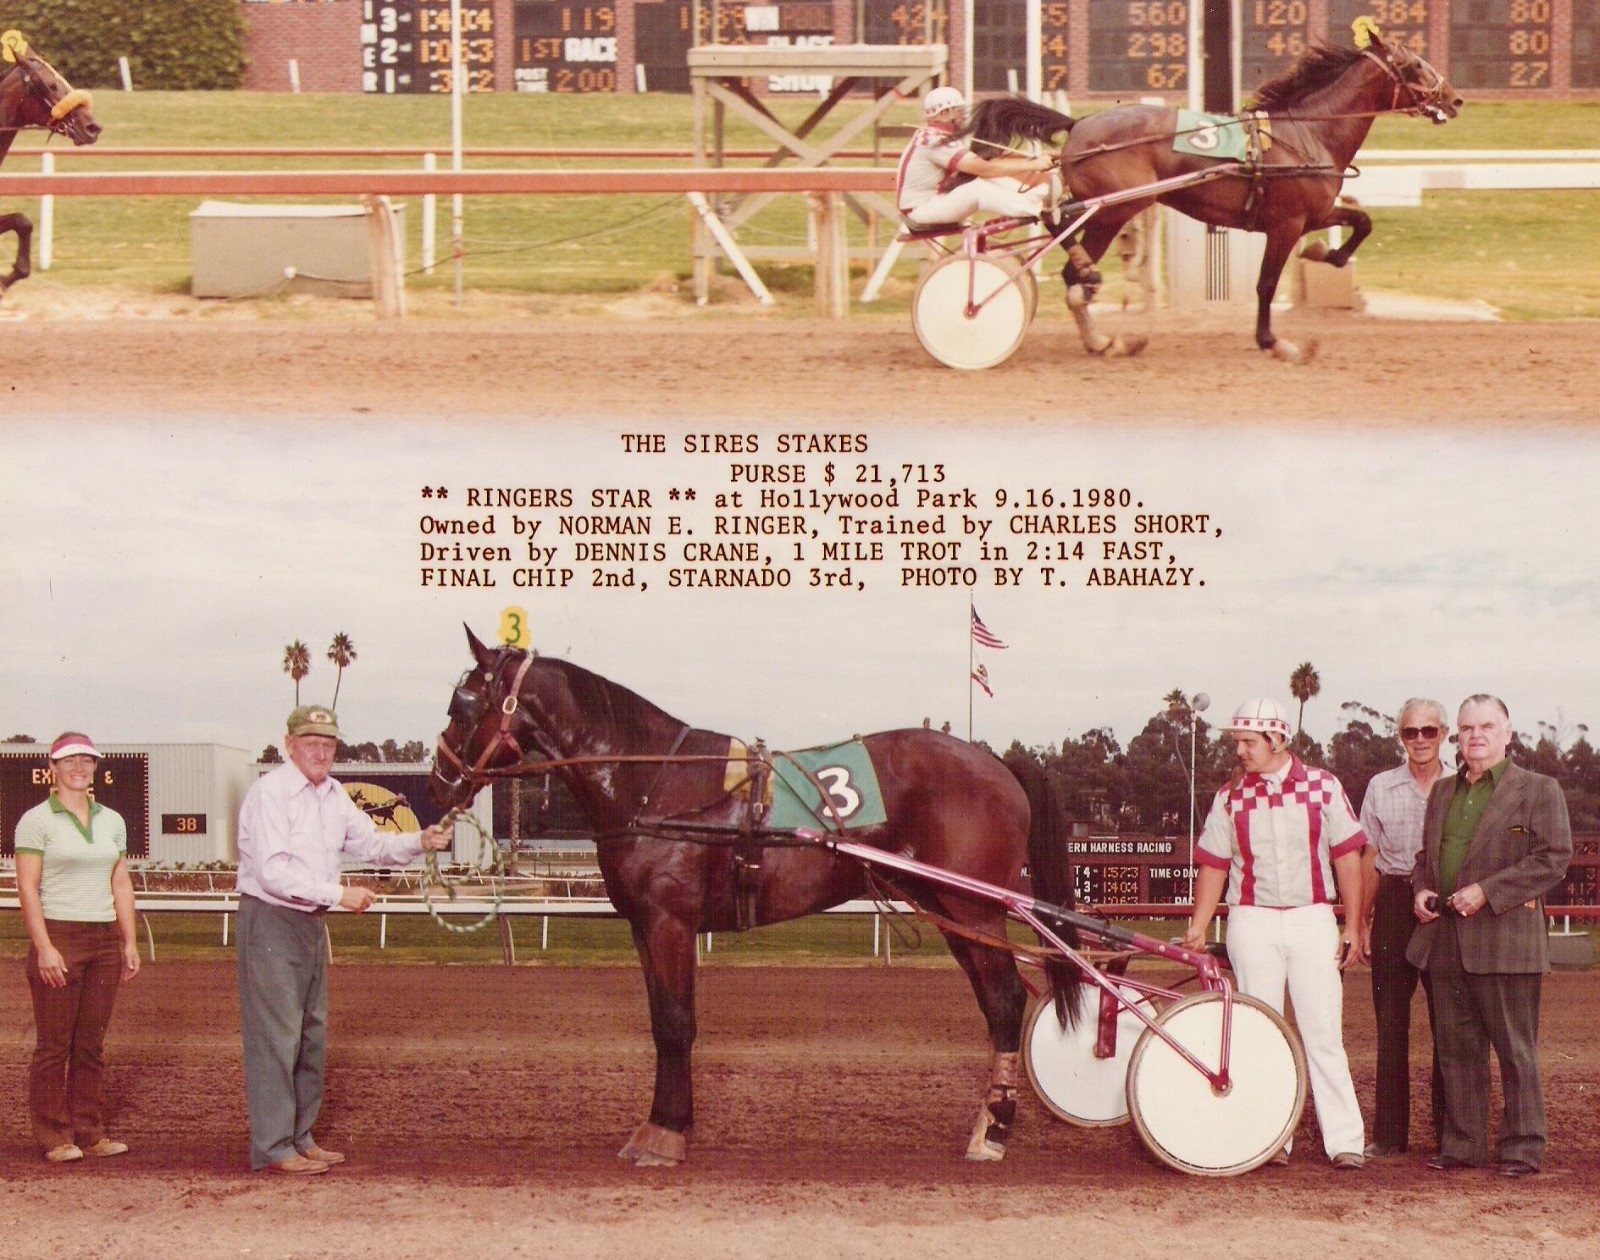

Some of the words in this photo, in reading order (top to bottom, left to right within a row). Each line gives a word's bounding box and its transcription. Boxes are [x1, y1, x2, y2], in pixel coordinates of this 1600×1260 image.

[1128, 2, 1187, 26] 560
[1255, 0, 1307, 25] 120
[1510, 0, 1550, 23] 80
[1128, 33, 1187, 57] 298
[1509, 30, 1550, 55] 80
[1147, 63, 1187, 88] 67
[1509, 62, 1549, 86] 27
[1189, 120, 1218, 150] 3
[507, 612, 521, 644] 3
[817, 766, 859, 817] 3
[176, 817, 197, 831] 38
[1090, 842, 1134, 853] HARNESS
[1137, 842, 1172, 853] RACING
[1149, 868, 1171, 878] TIME
